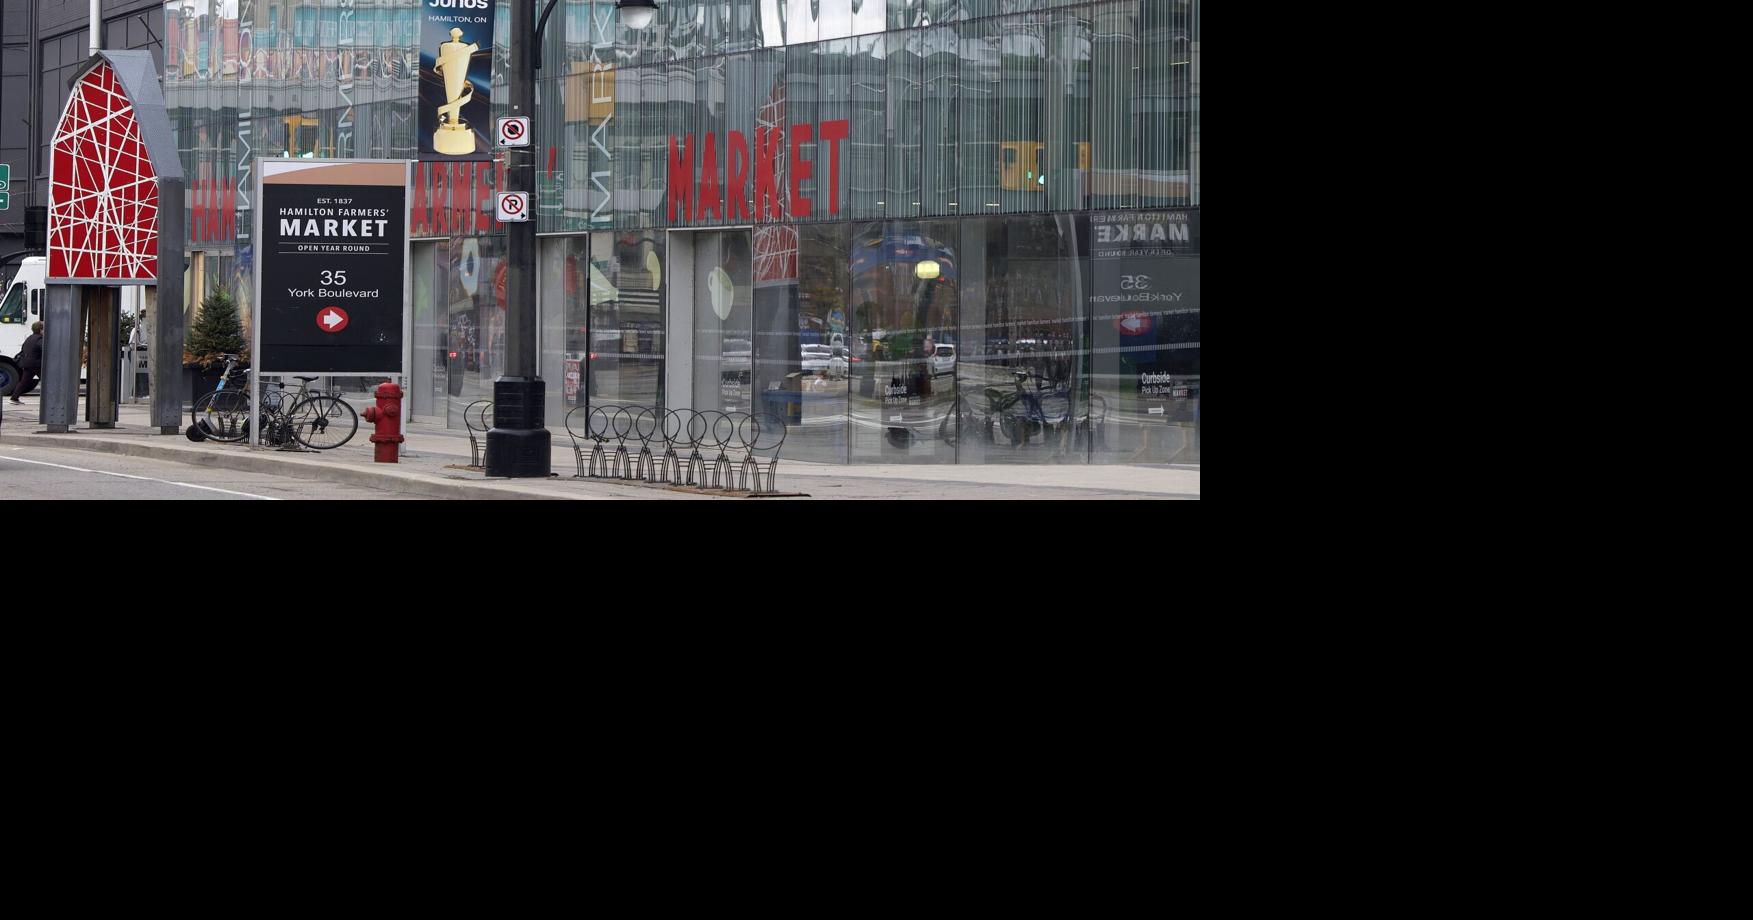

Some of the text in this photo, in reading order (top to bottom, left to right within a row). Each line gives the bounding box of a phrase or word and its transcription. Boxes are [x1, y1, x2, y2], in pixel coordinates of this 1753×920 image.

[428, 15, 472, 23] HAMILTON,
[668, 118, 849, 223] MARKET
[279, 207, 390, 217] HAMILTON FARMERS'
[279, 218, 388, 237] MARKET
[320, 270, 347, 286] 35
[288, 288, 379, 298] York Boulevard
[1141, 371, 1171, 384] Curbside
